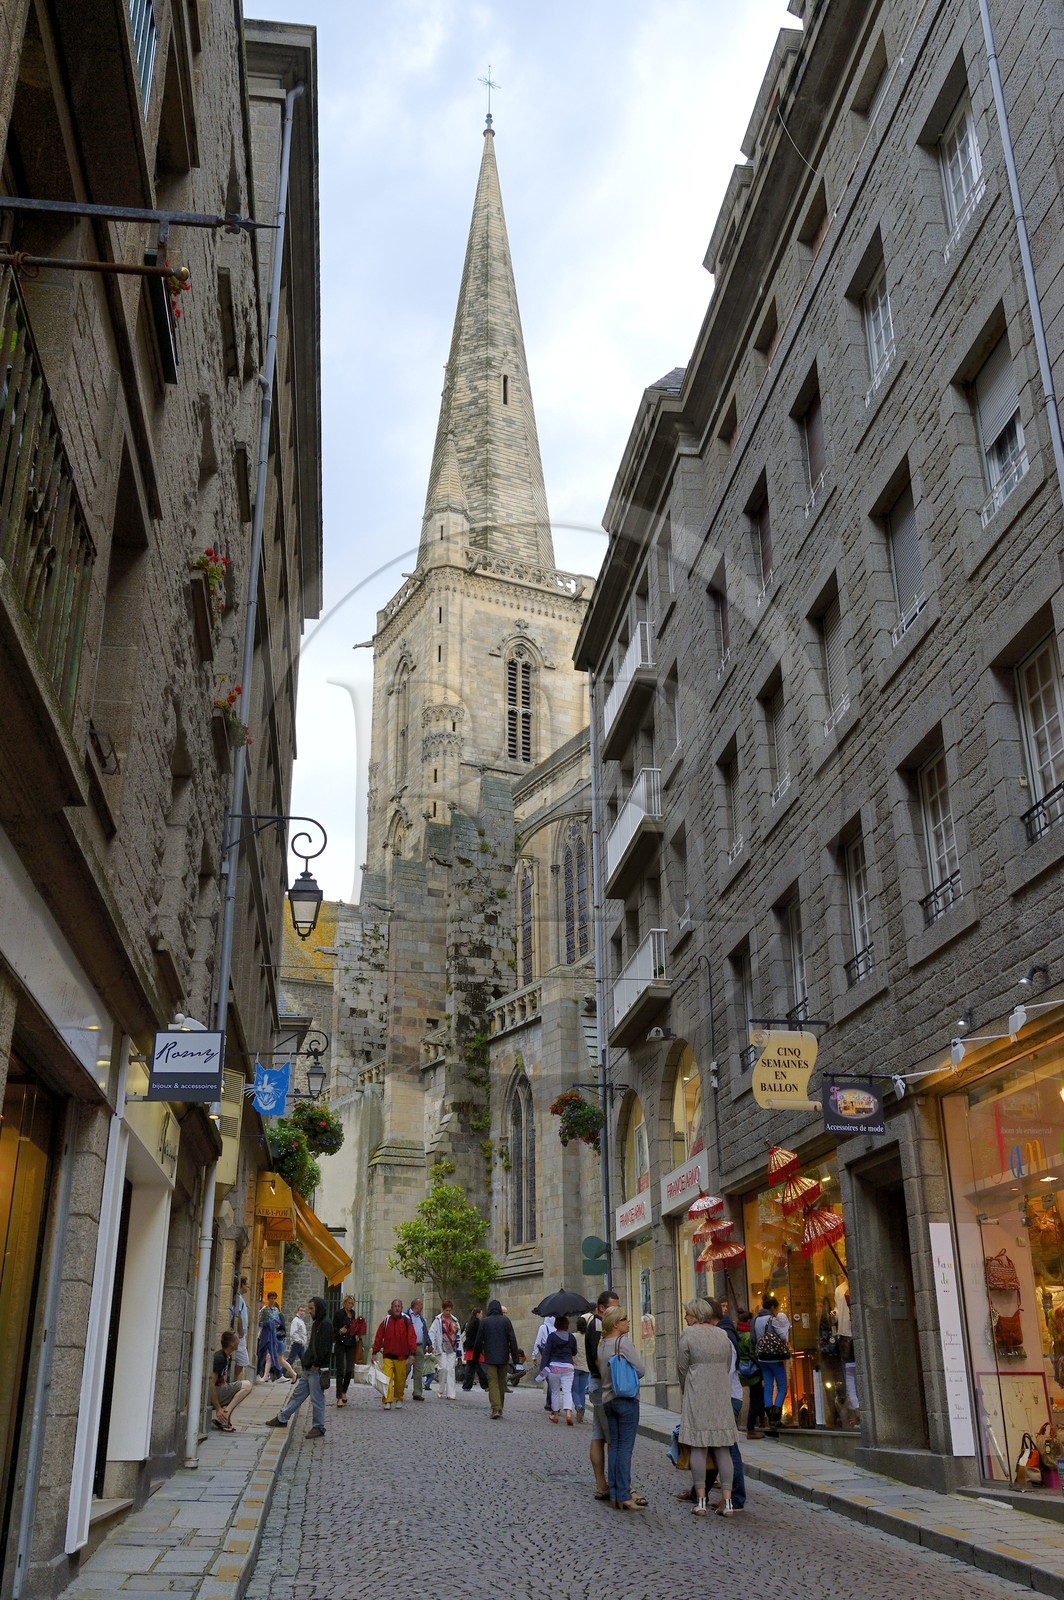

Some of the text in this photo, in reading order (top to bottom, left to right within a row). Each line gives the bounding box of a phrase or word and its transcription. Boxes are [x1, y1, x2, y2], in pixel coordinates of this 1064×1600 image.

[155, 1041, 219, 1063] Romy
[777, 1047, 801, 1058] CINQ
[761, 1058, 809, 1069] SEMAINES
[774, 1070, 787, 1080] EN
[760, 1082, 799, 1092] BALLON
[825, 1123, 884, 1133] Accessoires de mode
